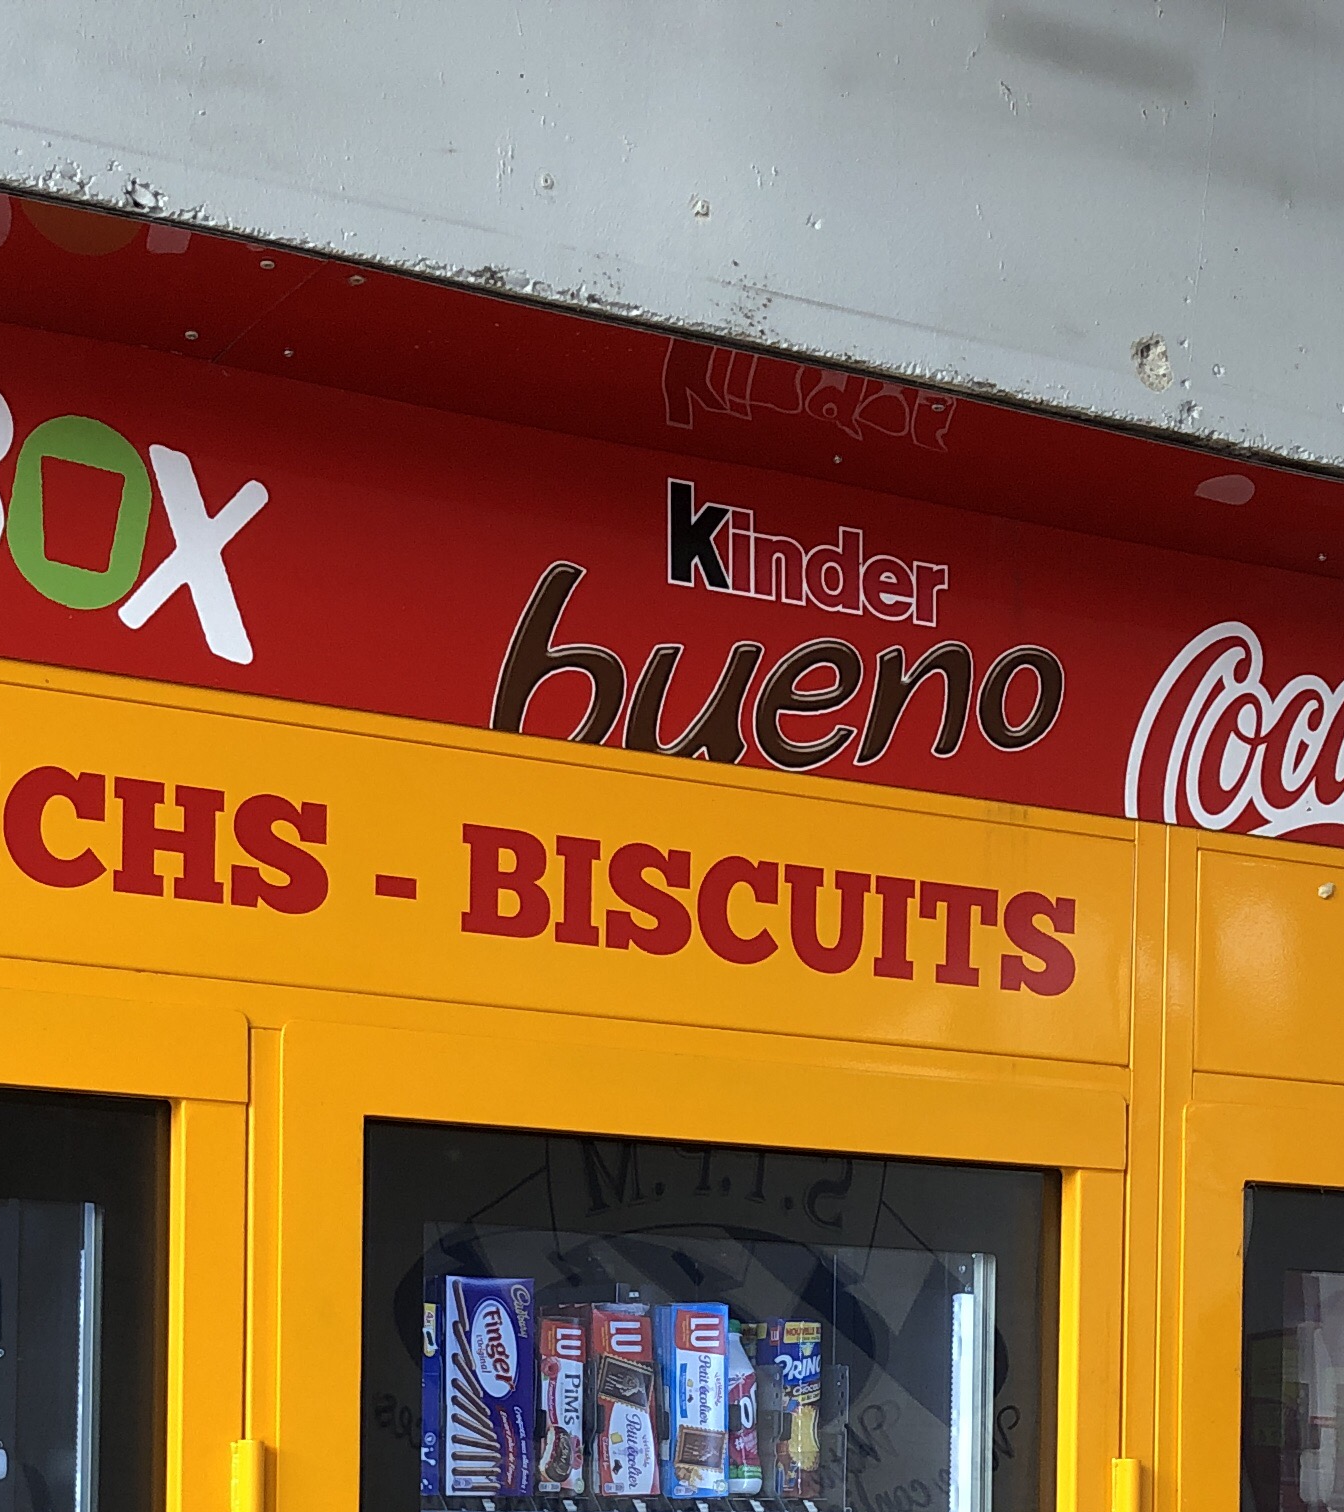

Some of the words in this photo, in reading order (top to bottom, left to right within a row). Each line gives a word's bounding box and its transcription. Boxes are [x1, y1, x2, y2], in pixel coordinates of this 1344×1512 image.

[667, 480, 948, 627] kinder
[490, 561, 1064, 771] bueno
[461, 824, 1077, 998] BISCUITS
[483, 1306, 516, 1391] Finger
[556, 1328, 583, 1356] LU
[609, 1320, 643, 1353] LU
[690, 1317, 720, 1348] LU
